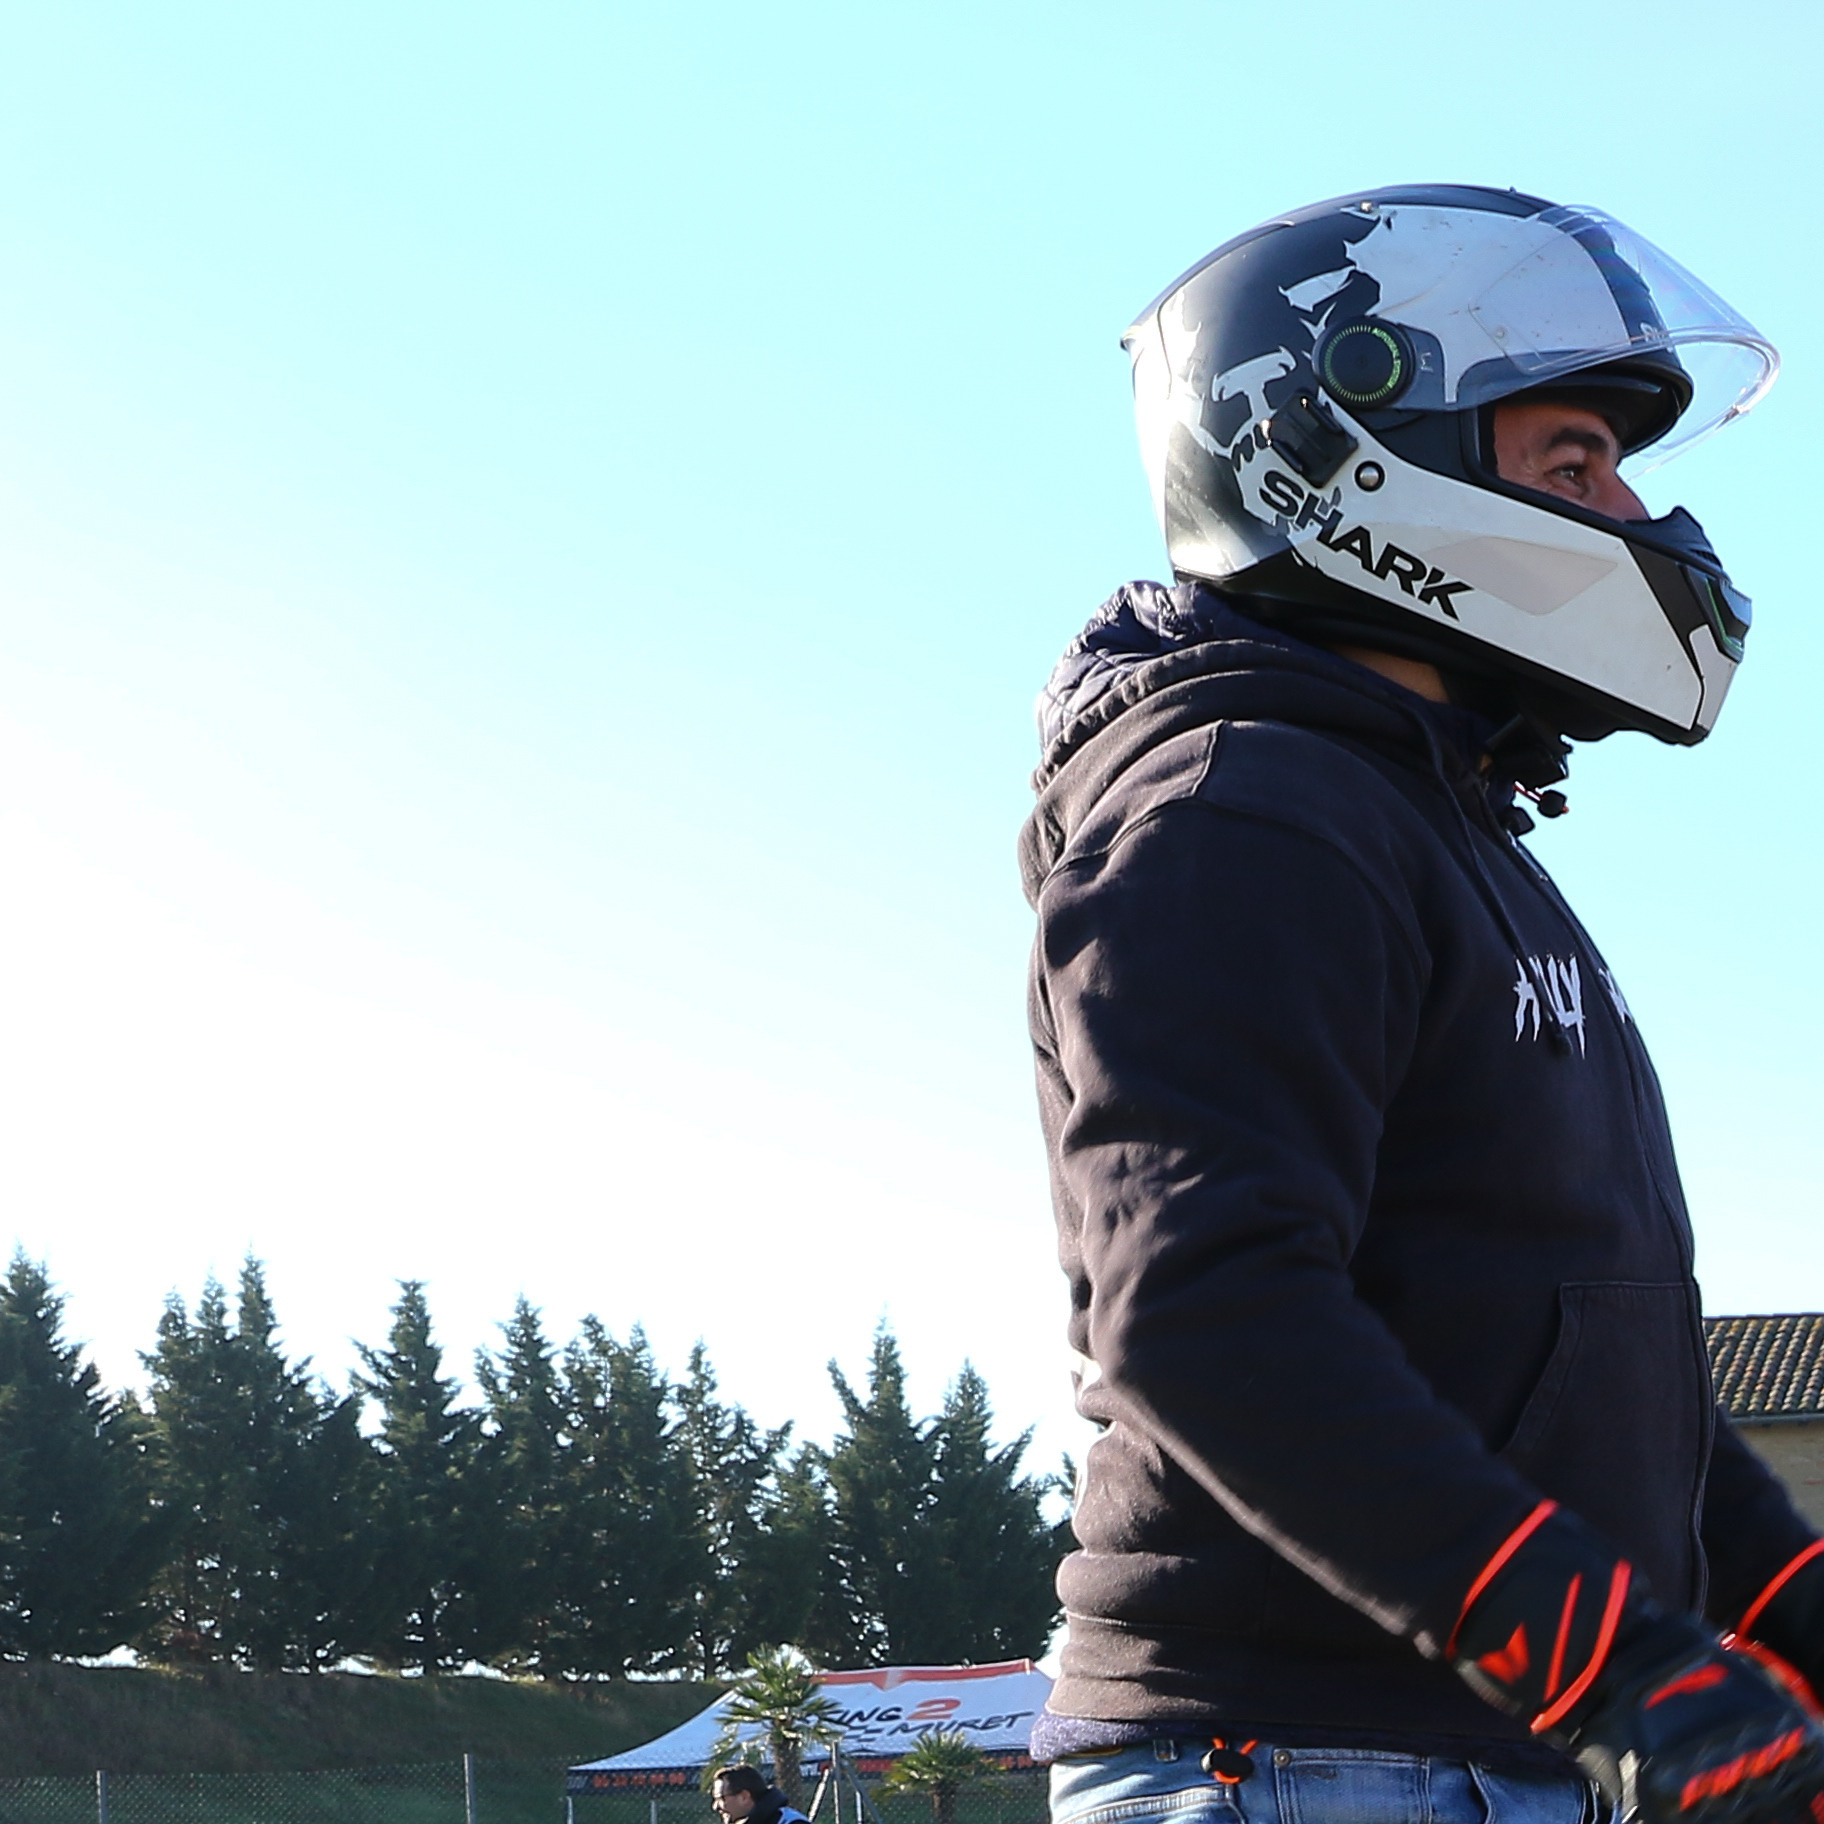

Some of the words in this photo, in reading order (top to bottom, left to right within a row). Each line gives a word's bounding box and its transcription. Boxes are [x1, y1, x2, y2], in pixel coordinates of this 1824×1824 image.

[1259, 470, 1476, 623] SHARK
[907, 1698, 961, 1720] 2
[888, 1710, 1035, 1737] MURET
